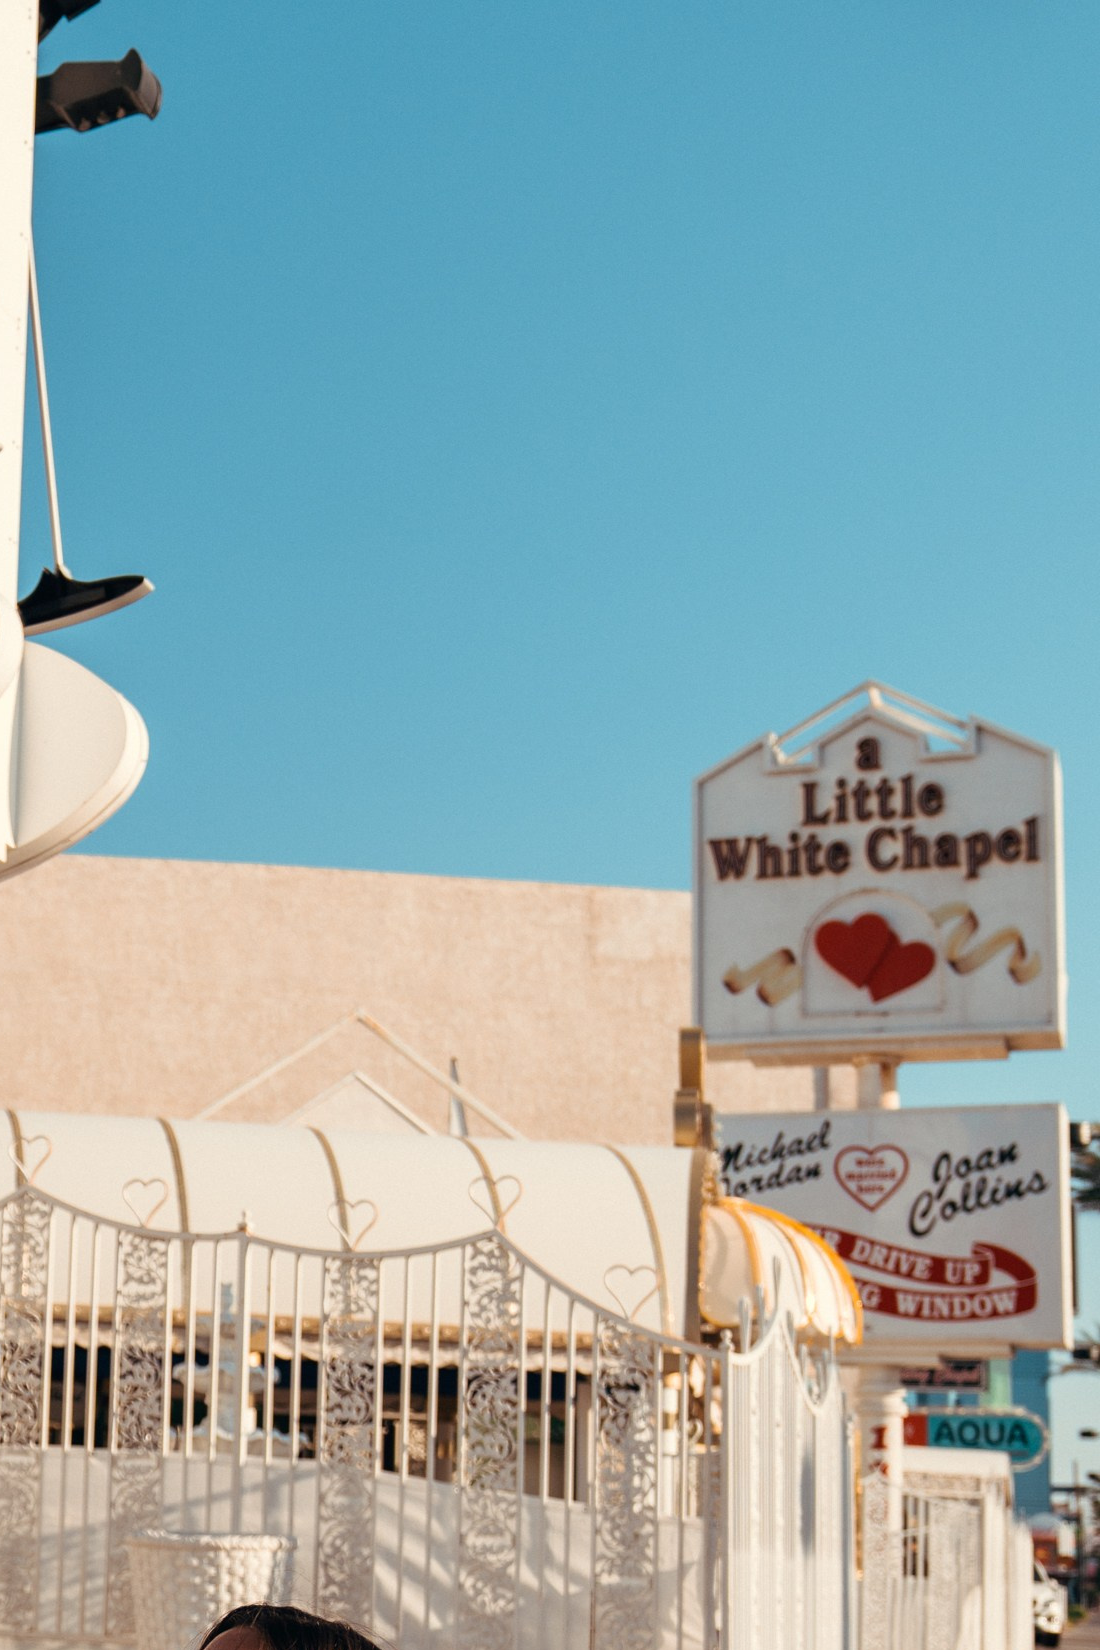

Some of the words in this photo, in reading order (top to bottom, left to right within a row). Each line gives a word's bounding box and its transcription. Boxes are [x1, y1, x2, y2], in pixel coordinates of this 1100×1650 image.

[856, 737, 881, 770] a
[802, 774, 944, 825] Little
[709, 831, 851, 881] White
[865, 816, 1041, 880] Chapel
[718, 1117, 831, 1174] Michael
[932, 1140, 1018, 1200] Joan
[909, 1169, 1048, 1238] Collins
[851, 1239, 933, 1280] DRIVE
[945, 1259, 982, 1285] UP
[896, 1288, 1019, 1320] WINDOW
[934, 1420, 1030, 1446] AQUA
